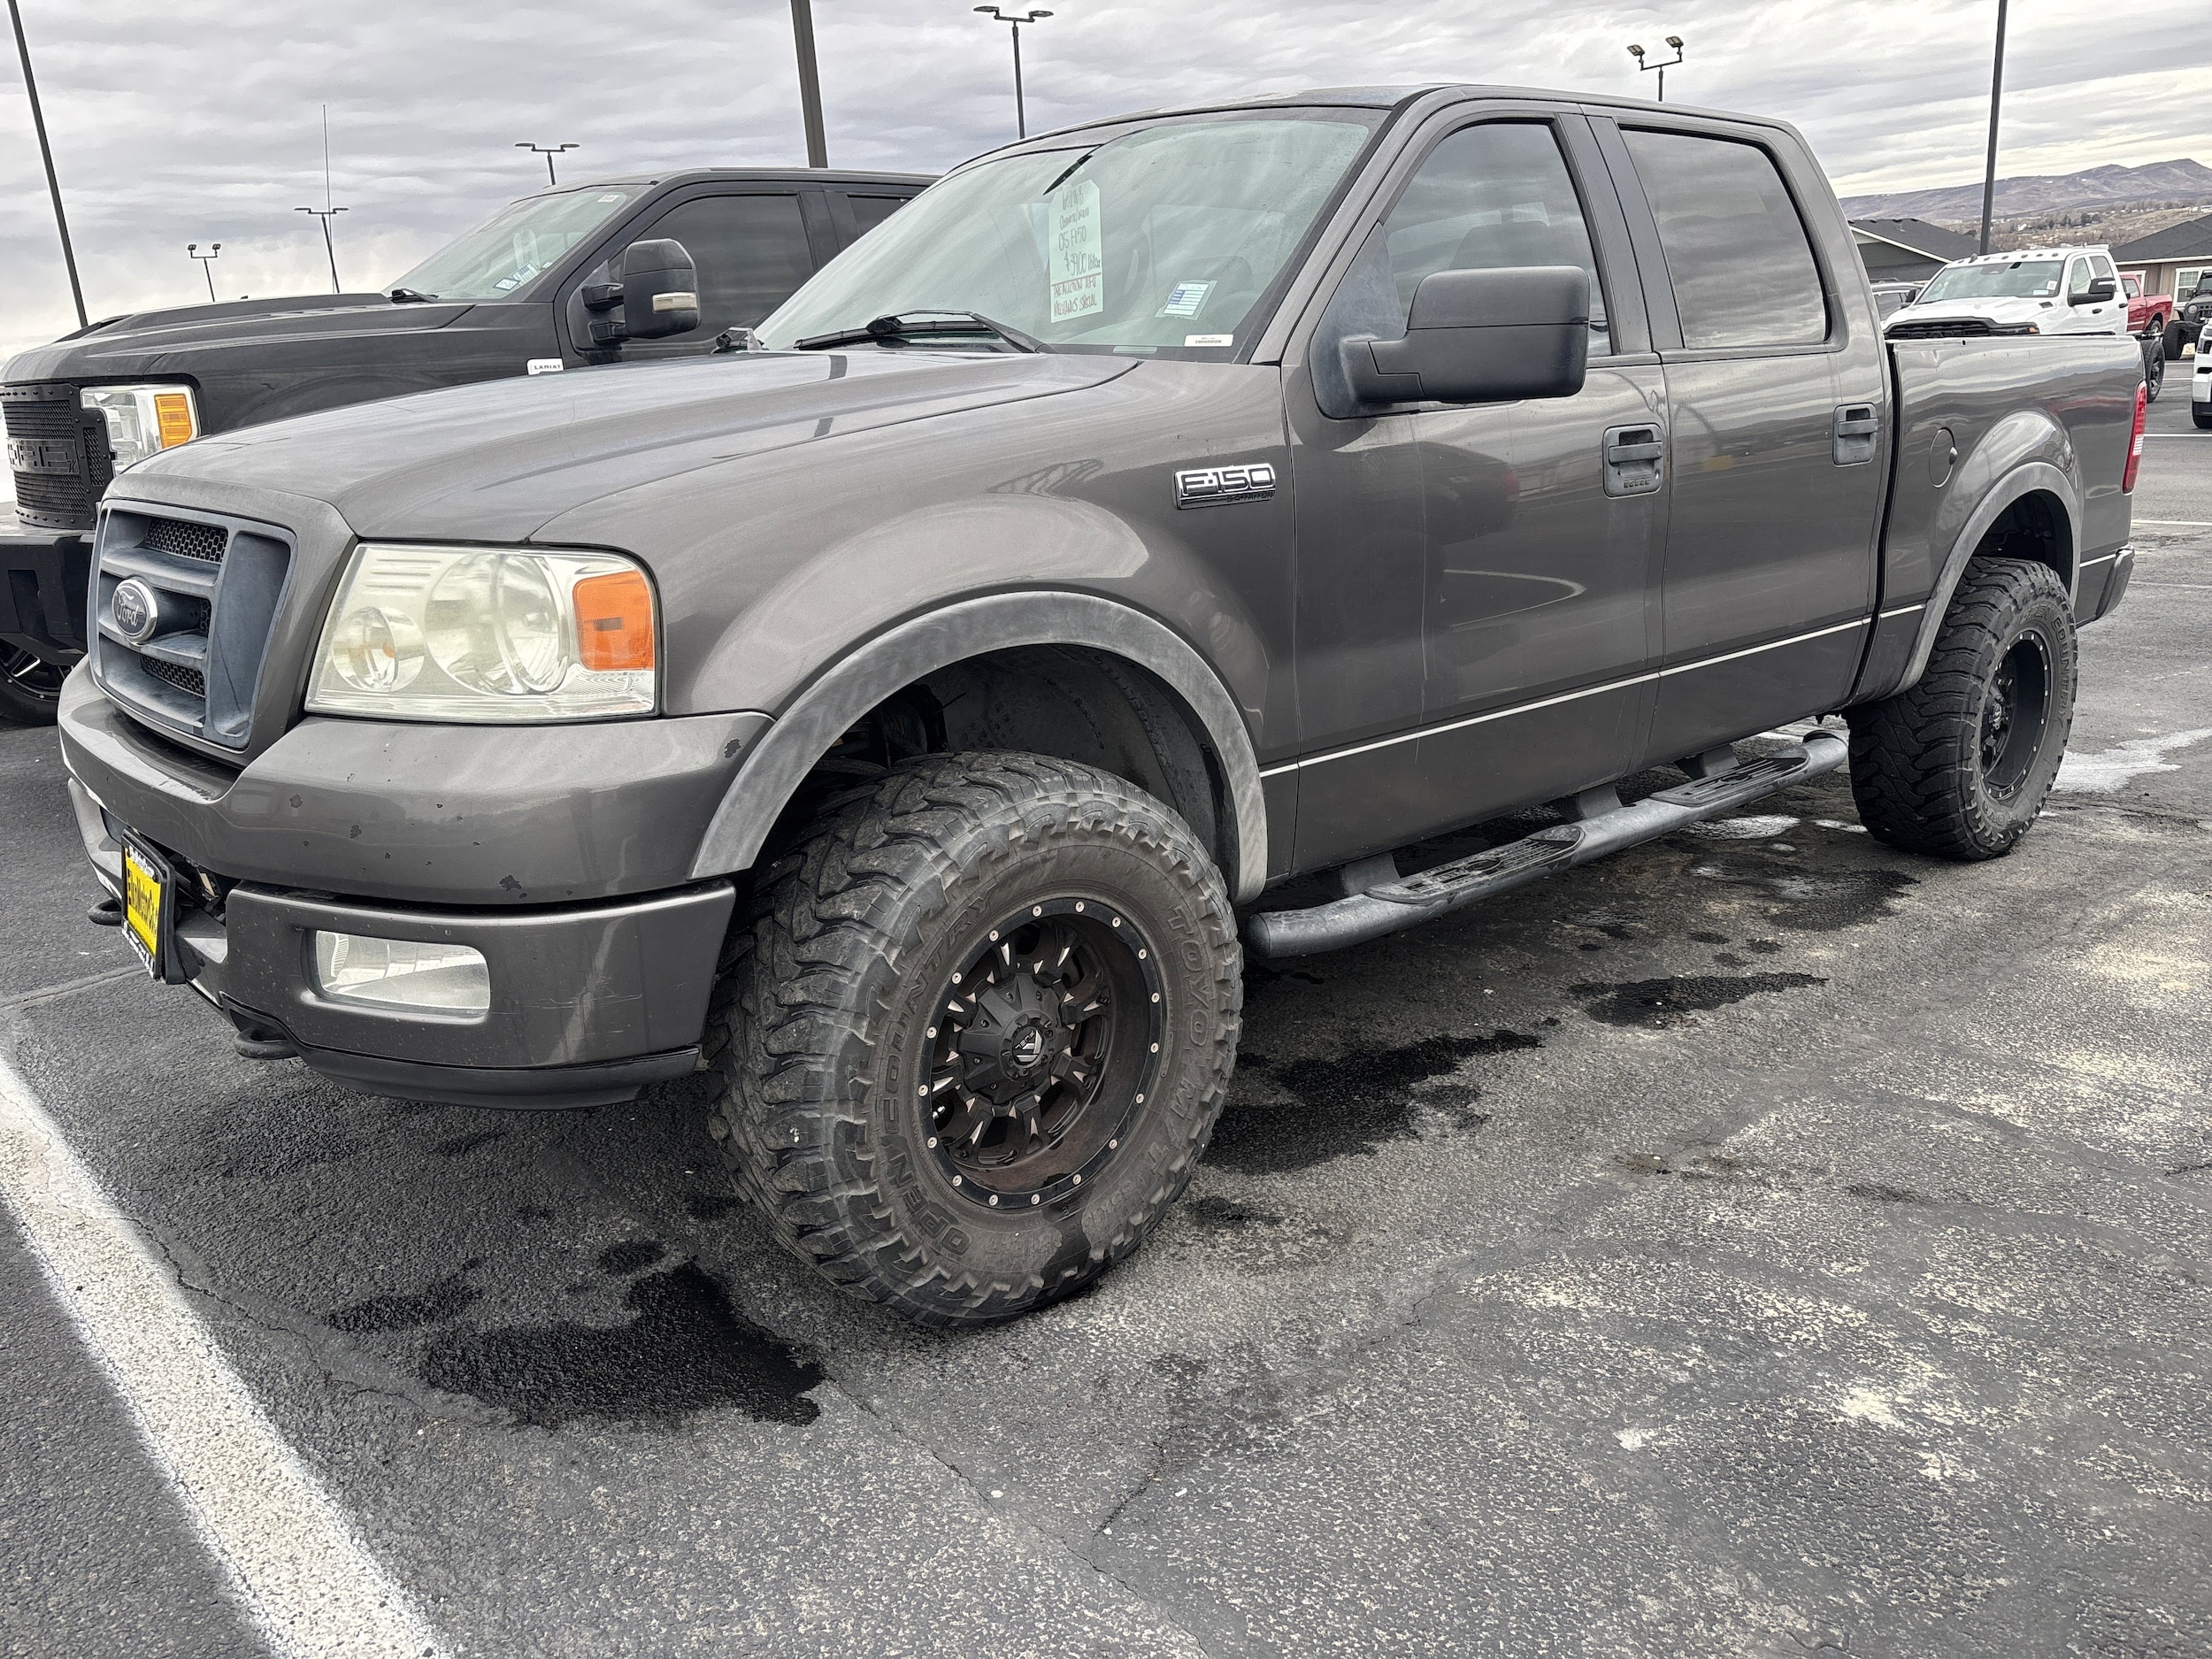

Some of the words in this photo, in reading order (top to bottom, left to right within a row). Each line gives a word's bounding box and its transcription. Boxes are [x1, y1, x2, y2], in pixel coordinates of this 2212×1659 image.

[116, 591, 139, 626] Ford
[884, 883, 998, 1134] COUNTRY
[1167, 905, 1209, 1046] TOYO
[1014, 1030, 1035, 1049] FUEL
[886, 1152, 972, 1256] OPEN
